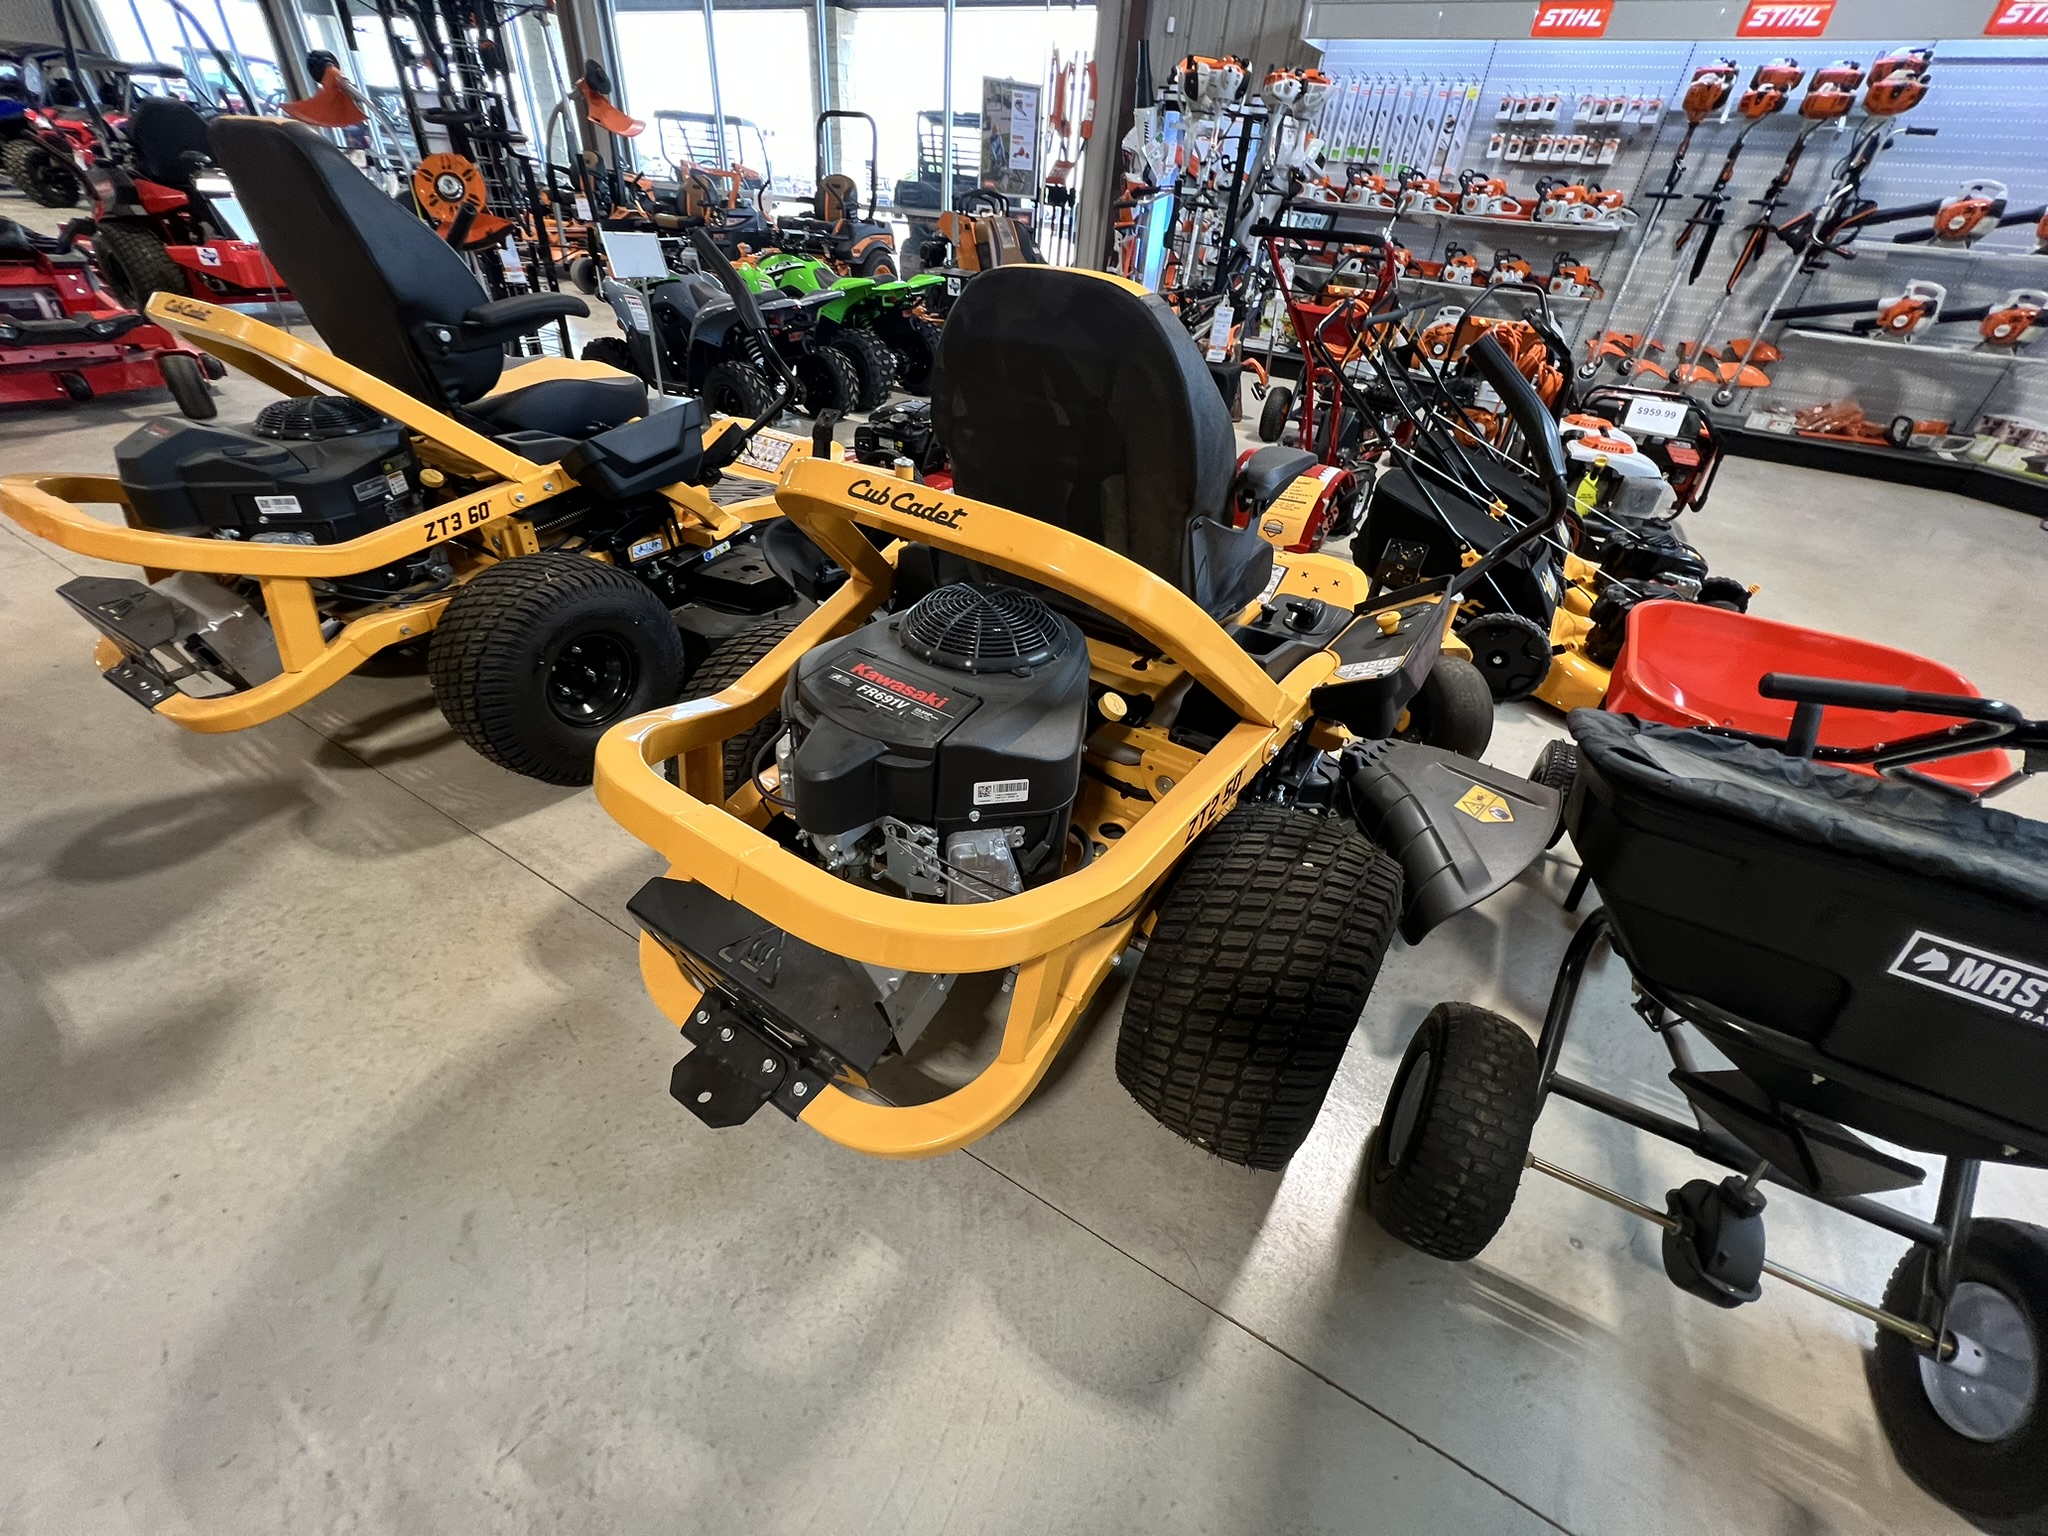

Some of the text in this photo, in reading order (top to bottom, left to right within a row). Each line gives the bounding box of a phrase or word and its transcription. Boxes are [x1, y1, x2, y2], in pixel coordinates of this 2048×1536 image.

[1539, 9, 1602, 27] STIHL
[1746, 7, 1822, 27] STIHL
[1997, 3, 2048, 24] STI
[1637, 406, 1677, 419] $959.99
[847, 480, 968, 530] Cub Cadet
[424, 502, 490, 542] ZT3 60
[850, 662, 949, 710] Kawasaki
[856, 683, 911, 709] FR691V
[1185, 769, 1244, 845] ZT2 50
[1948, 956, 2048, 1014] MAS
[2020, 1009, 2048, 1028] RA
